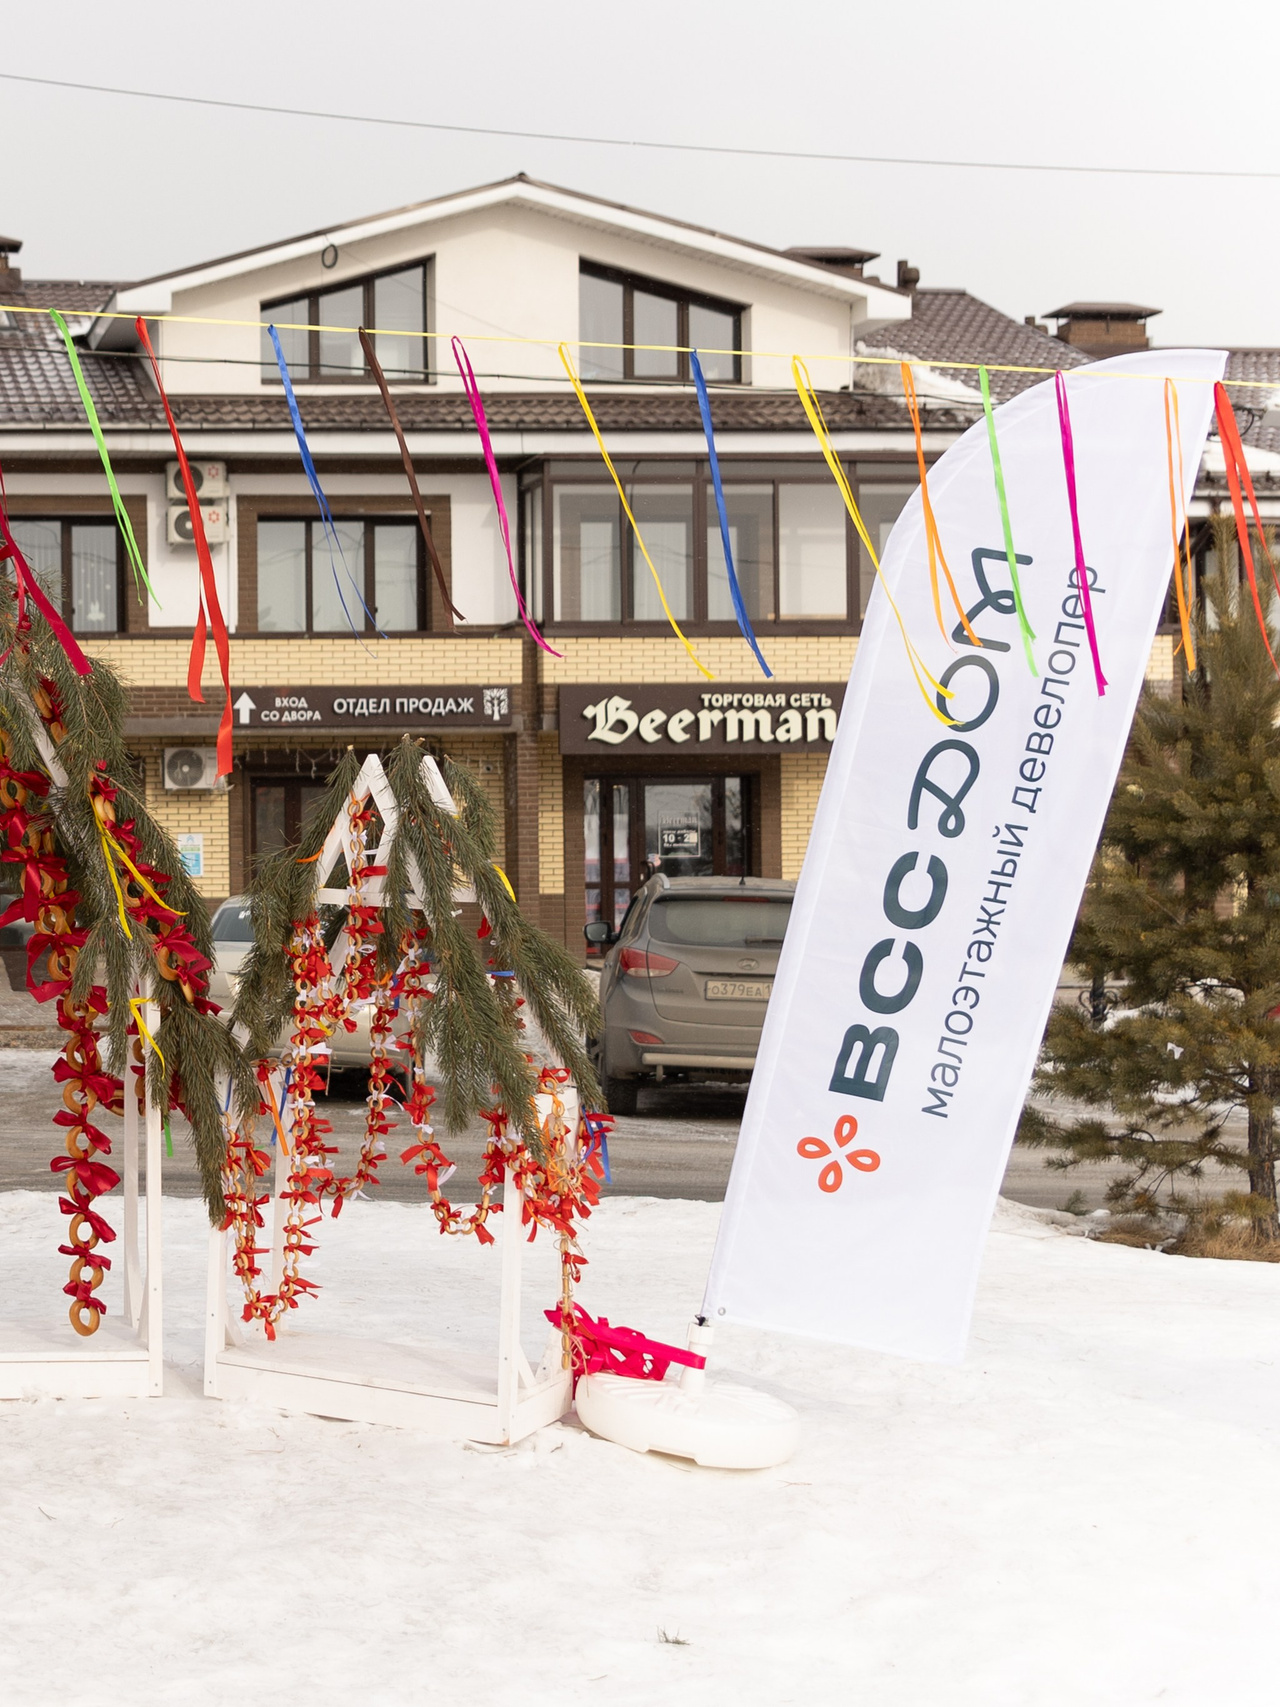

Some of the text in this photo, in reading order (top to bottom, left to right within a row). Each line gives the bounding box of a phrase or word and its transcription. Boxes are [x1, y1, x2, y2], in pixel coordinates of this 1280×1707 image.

[275, 696, 308, 709] ВХОД
[333, 697, 474, 717] ОТДЕЛ ПРОДАЖ
[701, 693, 832, 708] ТОРГОВАЯ СЕТЬ
[261, 710, 322, 723] СО ДВОРА
[582, 695, 837, 745] Beerman
[663, 833, 676, 843] 10
[921, 565, 1106, 1119] малоэтажный девелопер
